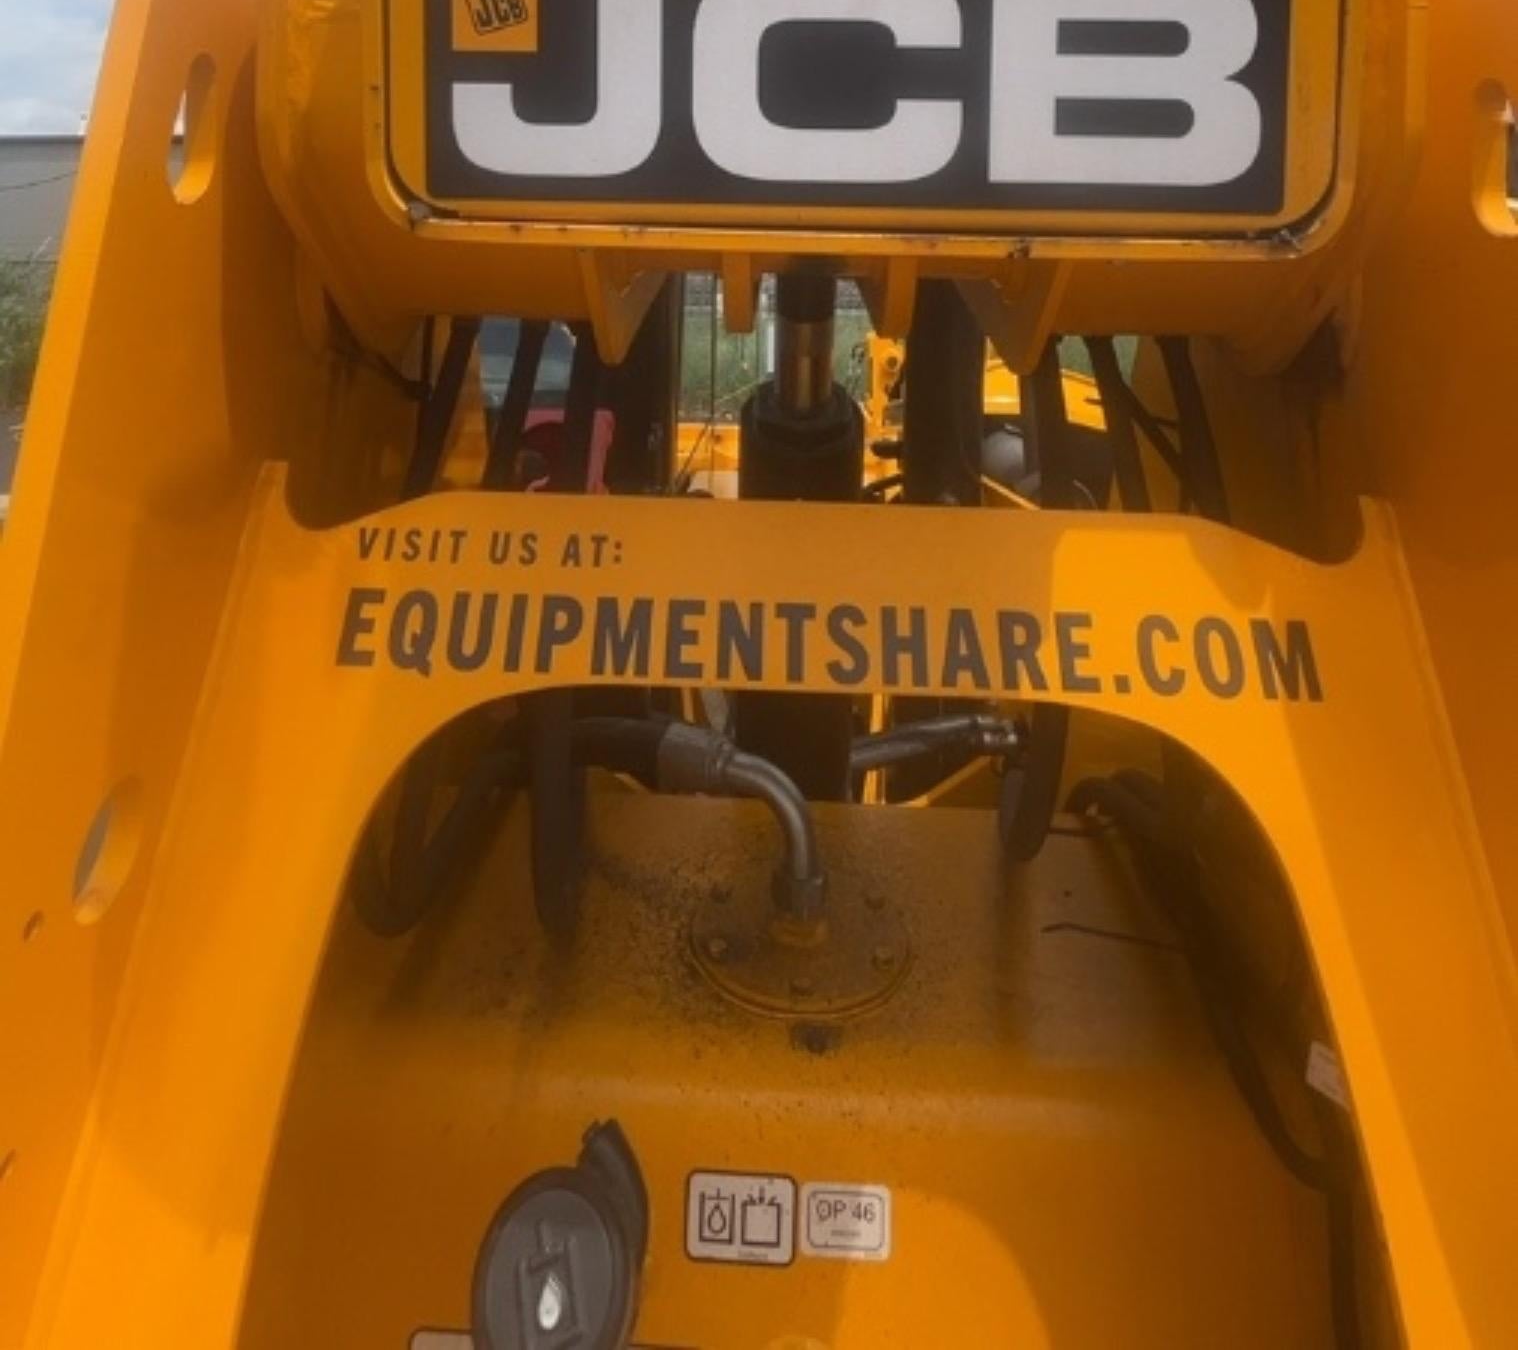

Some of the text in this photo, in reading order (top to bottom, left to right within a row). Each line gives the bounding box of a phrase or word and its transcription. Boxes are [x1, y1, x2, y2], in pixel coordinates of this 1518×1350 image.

[358, 527, 623, 568] VISIT US AT:
[336, 587, 1324, 703] EQUIPMENTSHARE.COM
[851, 1201, 877, 1224] 46
